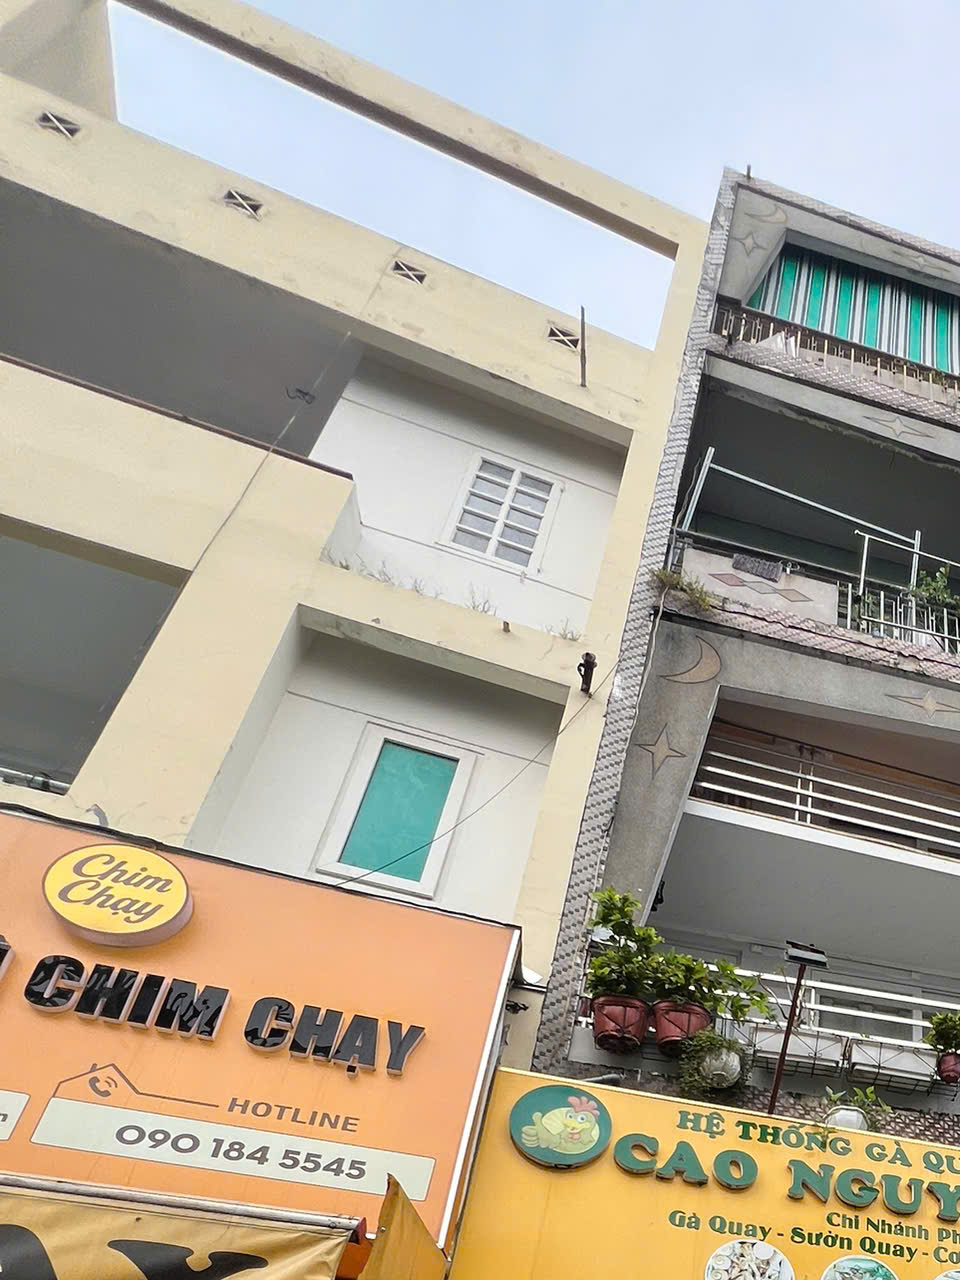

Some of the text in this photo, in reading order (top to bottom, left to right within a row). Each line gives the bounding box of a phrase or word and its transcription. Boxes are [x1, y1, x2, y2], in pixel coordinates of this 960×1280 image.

[72, 853, 174, 893] Chim
[57, 878, 165, 924] Chạy
[24, 954, 232, 1042] CHIM
[243, 996, 426, 1078] CHẠY
[228, 1097, 361, 1134] HOTLINE
[676, 1109, 726, 1141] HỆ
[863, 1139, 913, 1169] GÀ
[115, 1123, 367, 1181] 090 184 5545
[613, 1132, 759, 1191] CAO
[668, 1209, 701, 1231] Gà
[708, 1214, 773, 1243] Quay
[789, 1225, 853, 1252] Sườn
[859, 1235, 918, 1263] Quay
[866, 1216, 930, 1241] Nhánh
